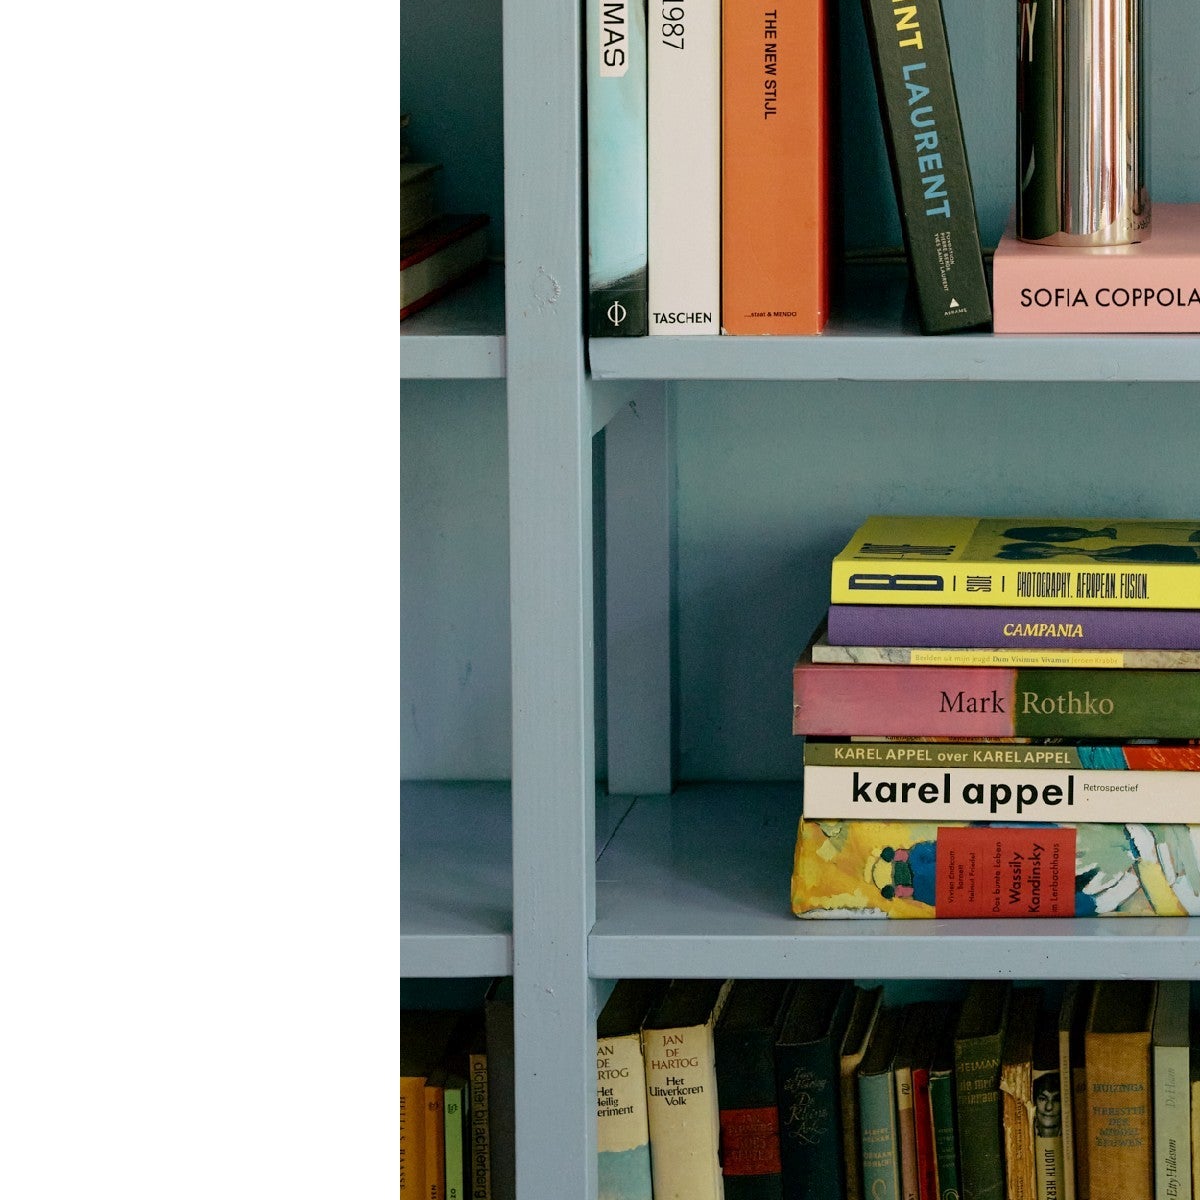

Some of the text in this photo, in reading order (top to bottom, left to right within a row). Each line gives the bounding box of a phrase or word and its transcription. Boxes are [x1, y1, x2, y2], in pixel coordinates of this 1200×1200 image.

[764, 8, 778, 120] THE NEW STIJL
[902, 62, 952, 219] LAURENT
[1020, 287, 1089, 308] SOFIA
[653, 312, 713, 326] TASCHEN
[1016, 571, 1151, 600] PHOTOGRAPHY. AFROPEAN. FUSION.
[1002, 622, 1085, 639] CAMPANIA
[939, 690, 1114, 715] Mark Rothko
[834, 747, 1072, 765] KAREL APPEL over KAREL APPEL
[851, 772, 1140, 813] karel appel Retrospectief
[1009, 852, 1024, 904] Wassily
[1028, 842, 1045, 912] Kandinsky
[662, 1034, 685, 1046] JAN
[665, 1048, 680, 1058] DE
[651, 1058, 699, 1070] HARTOG
[474, 1063, 488, 1106] dichter
[649, 1084, 704, 1097] Uitverkoren
[665, 1076, 685, 1086] Het
[664, 1096, 687, 1107] Volk
